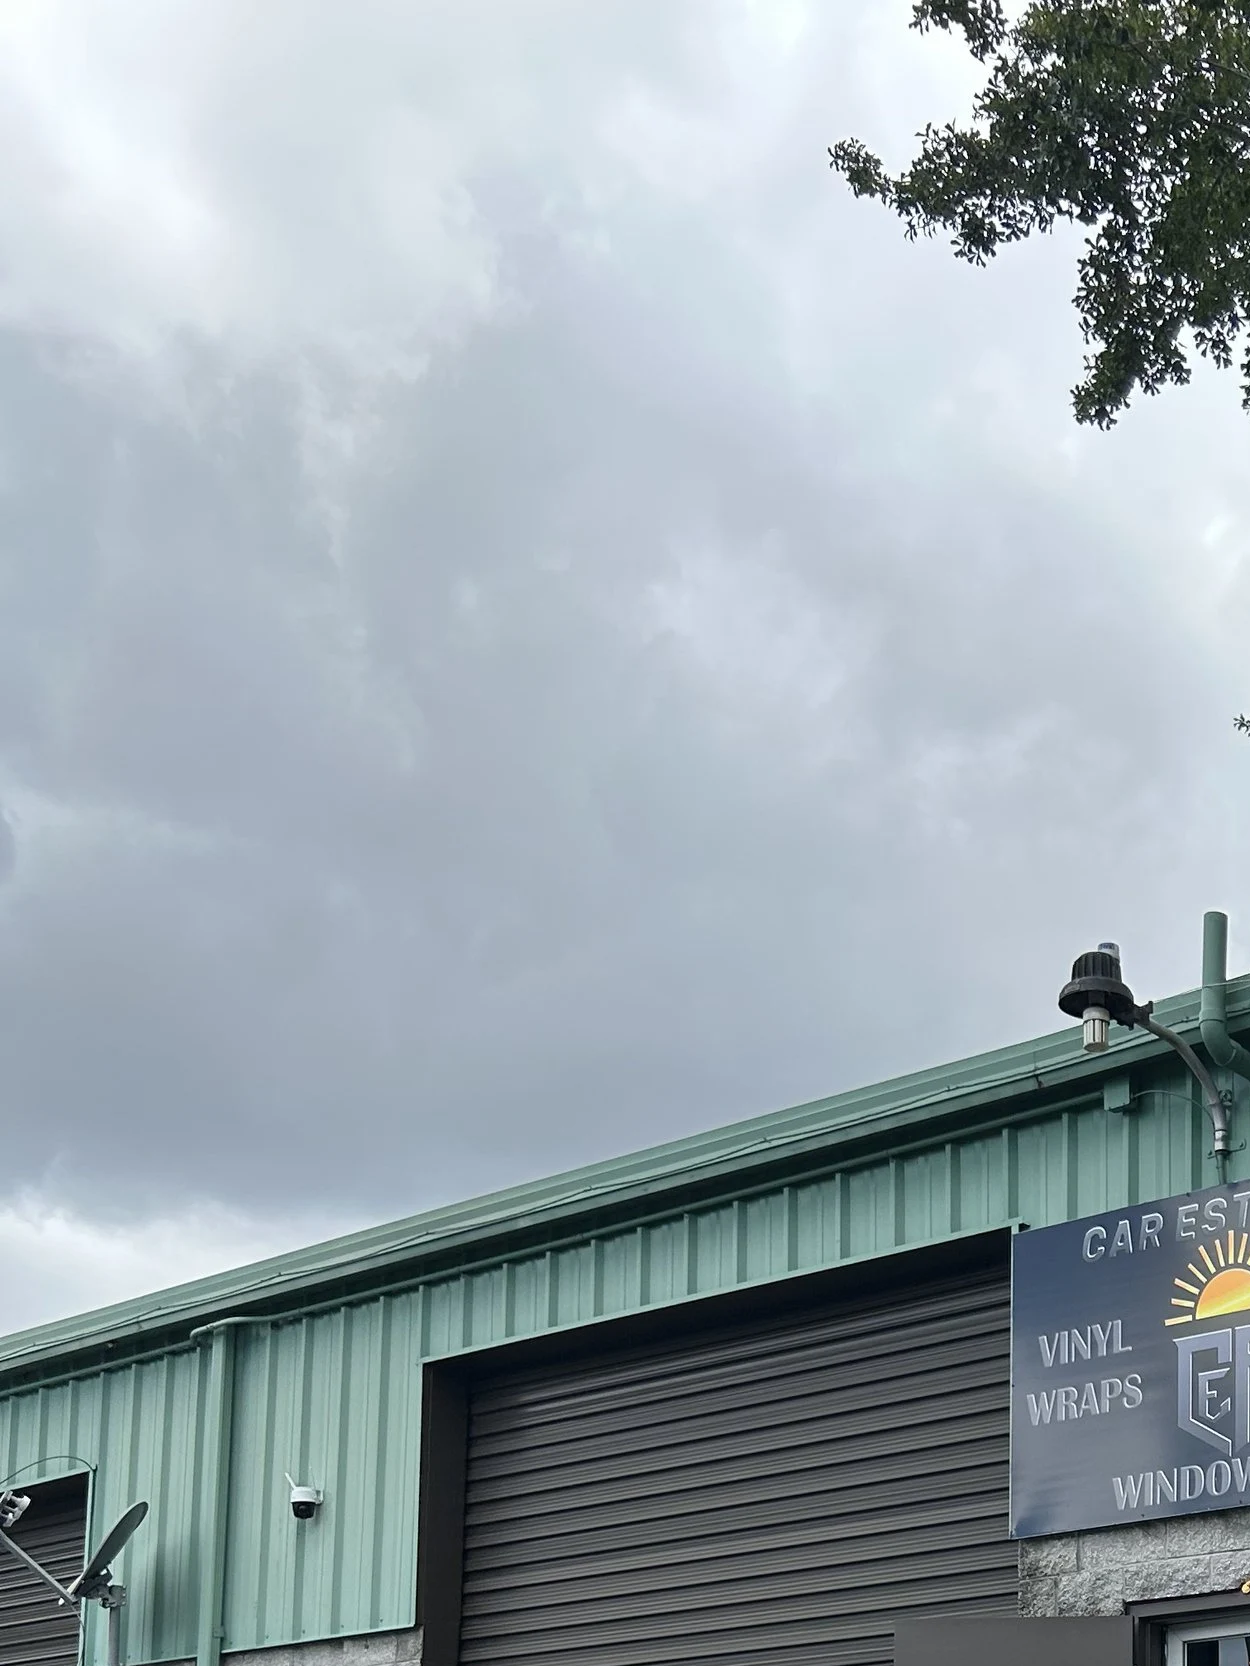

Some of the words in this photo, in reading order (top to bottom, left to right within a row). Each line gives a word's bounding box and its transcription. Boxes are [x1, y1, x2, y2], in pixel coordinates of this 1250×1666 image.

[1082, 1212, 1164, 1263] CAR
[1038, 1320, 1133, 1368] VINYL
[1026, 1374, 1143, 1426] WRAPS
